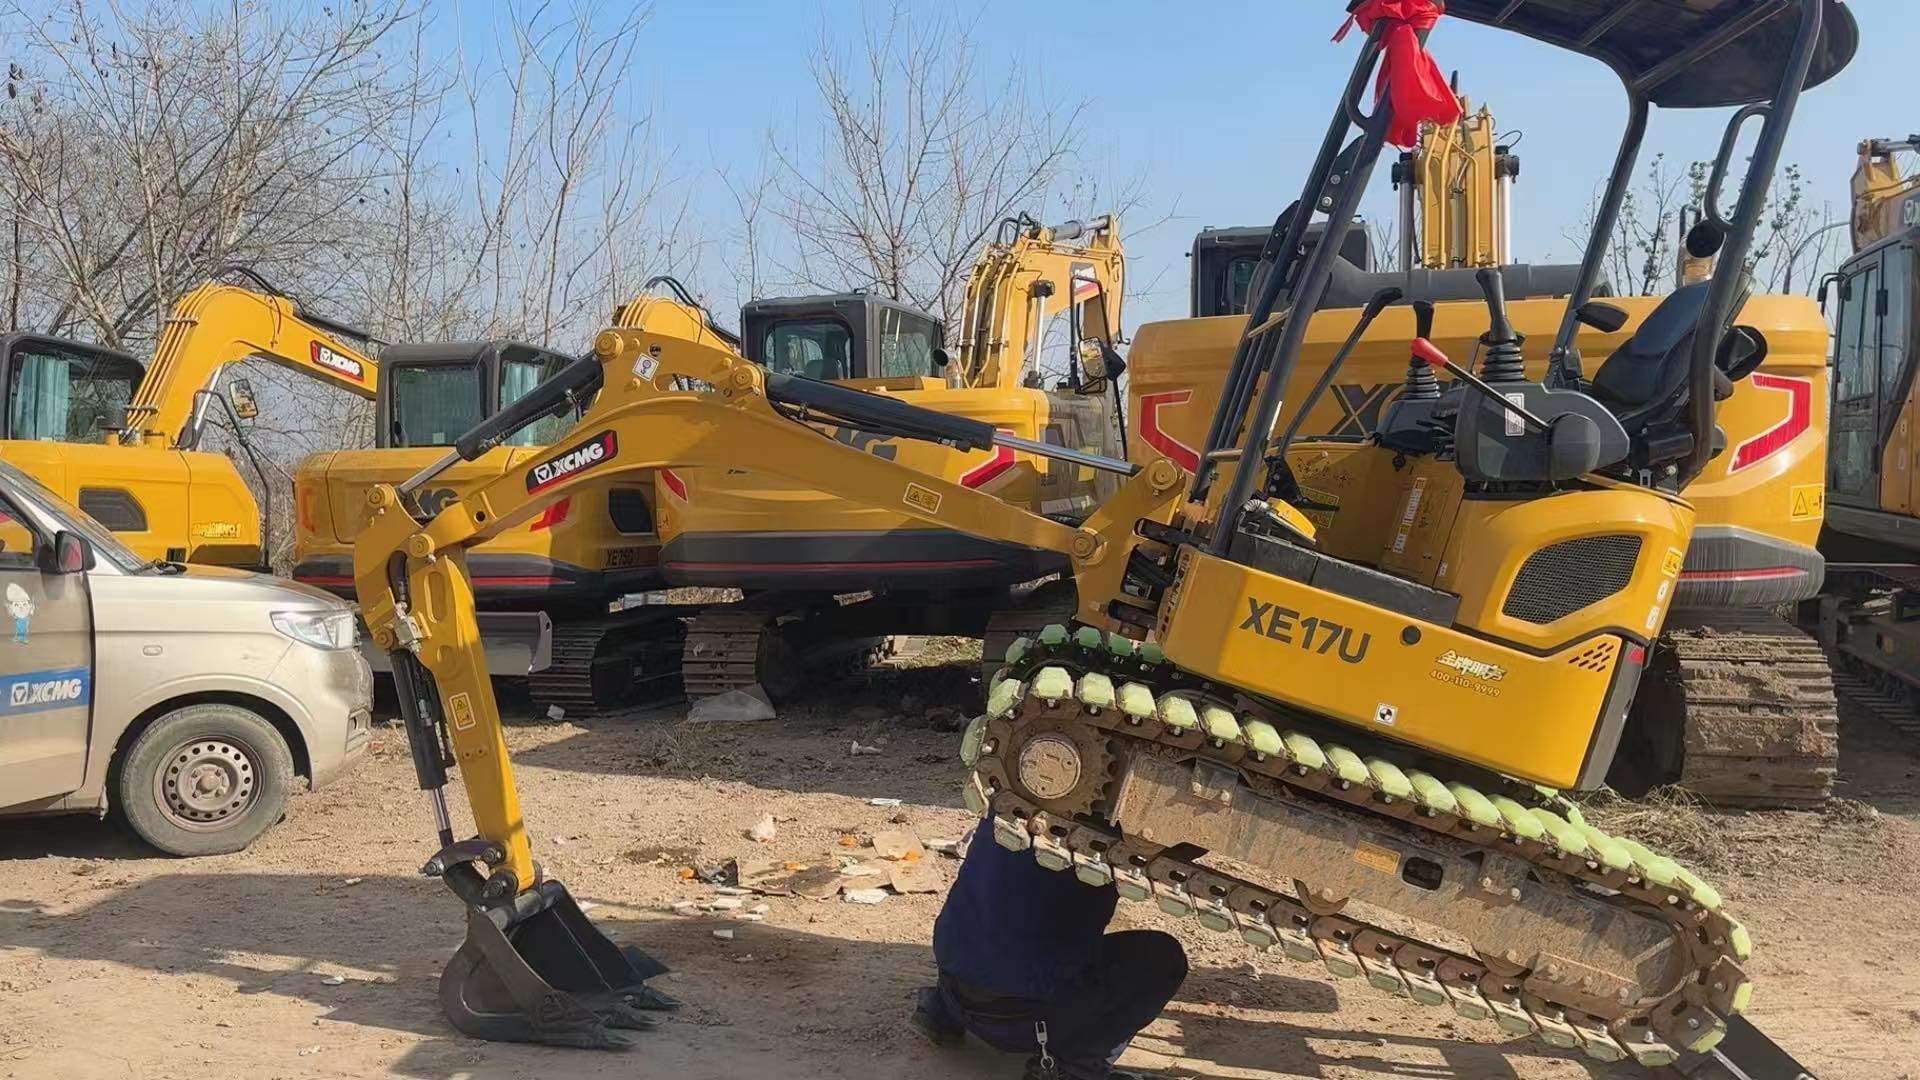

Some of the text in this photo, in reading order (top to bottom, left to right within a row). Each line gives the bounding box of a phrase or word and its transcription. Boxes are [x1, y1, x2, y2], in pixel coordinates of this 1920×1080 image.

[552, 442, 604, 477] XCMG
[1239, 596, 1371, 664] XE17U
[30, 678, 82, 703] XCMG
